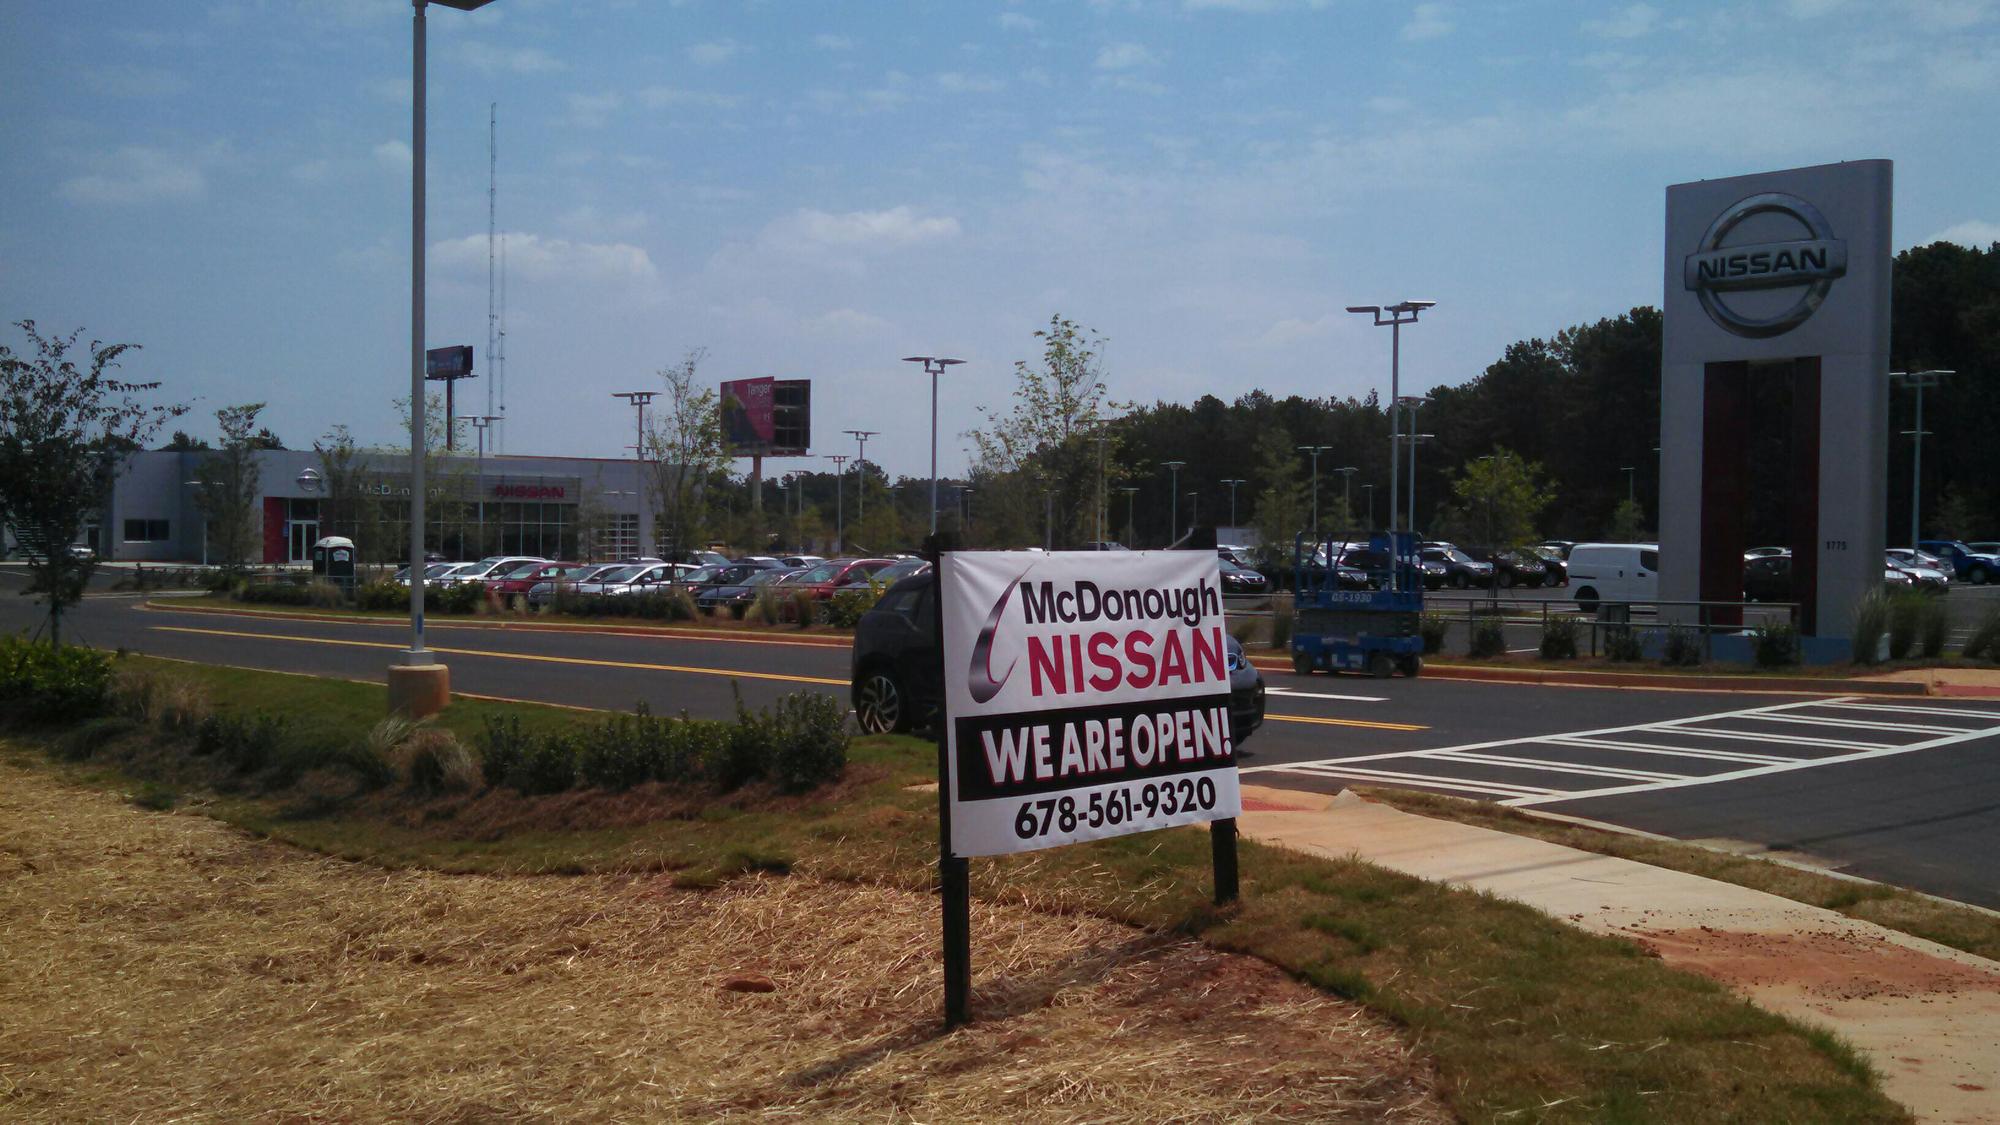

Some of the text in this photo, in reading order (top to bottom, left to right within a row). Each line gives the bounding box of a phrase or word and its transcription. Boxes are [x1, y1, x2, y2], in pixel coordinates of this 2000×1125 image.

[1698, 247, 1827, 279] NISSAN
[495, 484, 565, 498] NISSAN
[1020, 578, 1220, 627] McDonough
[1027, 627, 1226, 697] NISSAN
[981, 707, 1232, 785] WE ARE OPEN!
[1015, 776, 1217, 840] 678-561-9320
